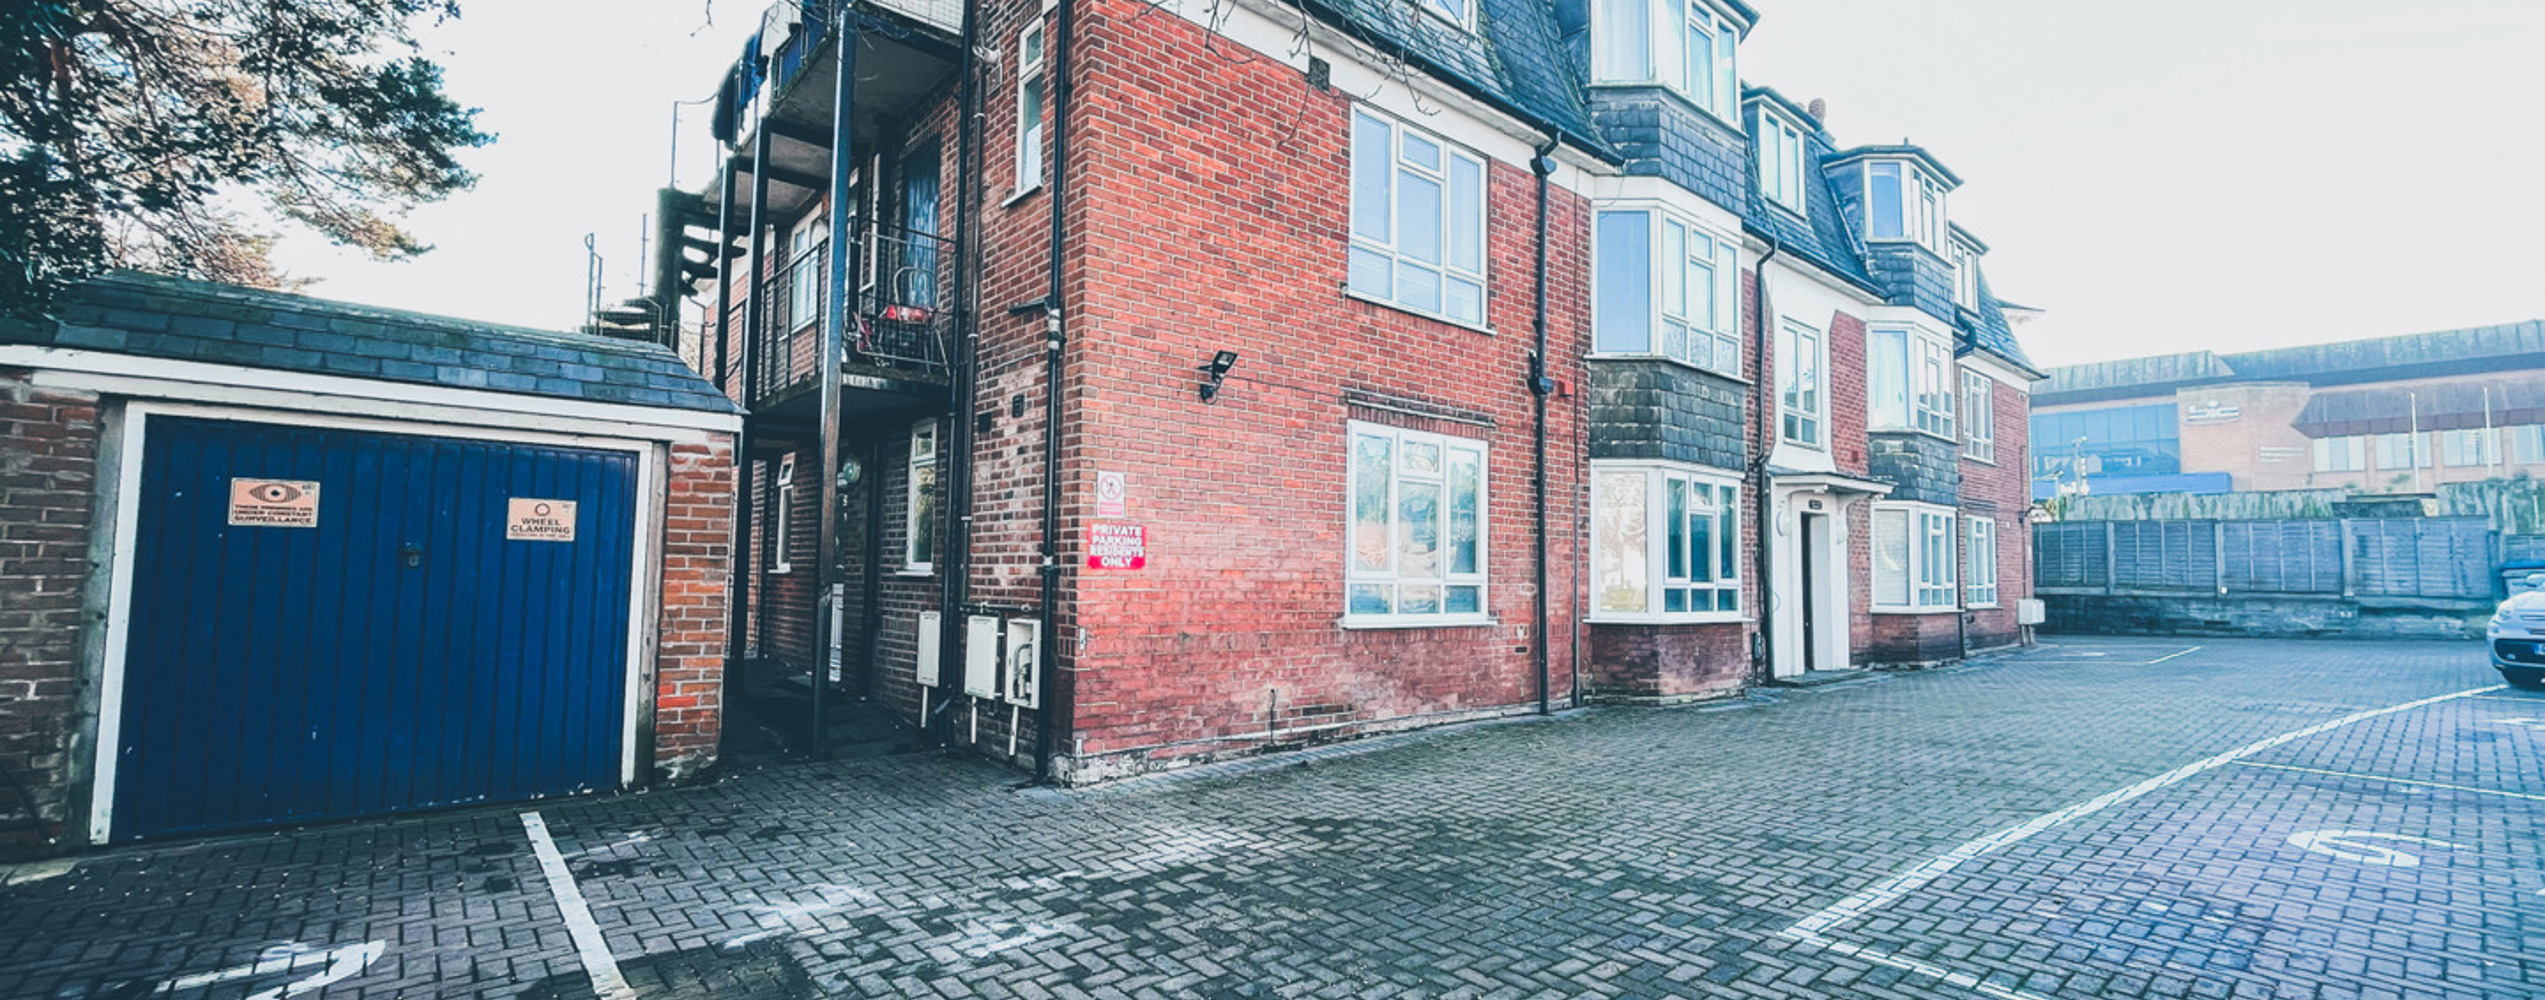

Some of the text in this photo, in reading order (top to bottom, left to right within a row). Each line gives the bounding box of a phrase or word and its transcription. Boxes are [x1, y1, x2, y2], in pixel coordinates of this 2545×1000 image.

[510, 525, 570, 534] CLAMPING
[1092, 524, 1142, 536] PRIVATE
[1092, 535, 1142, 546] PARKING
[1089, 545, 1145, 557] RESIDENTS
[1101, 556, 1133, 567] ONLY
